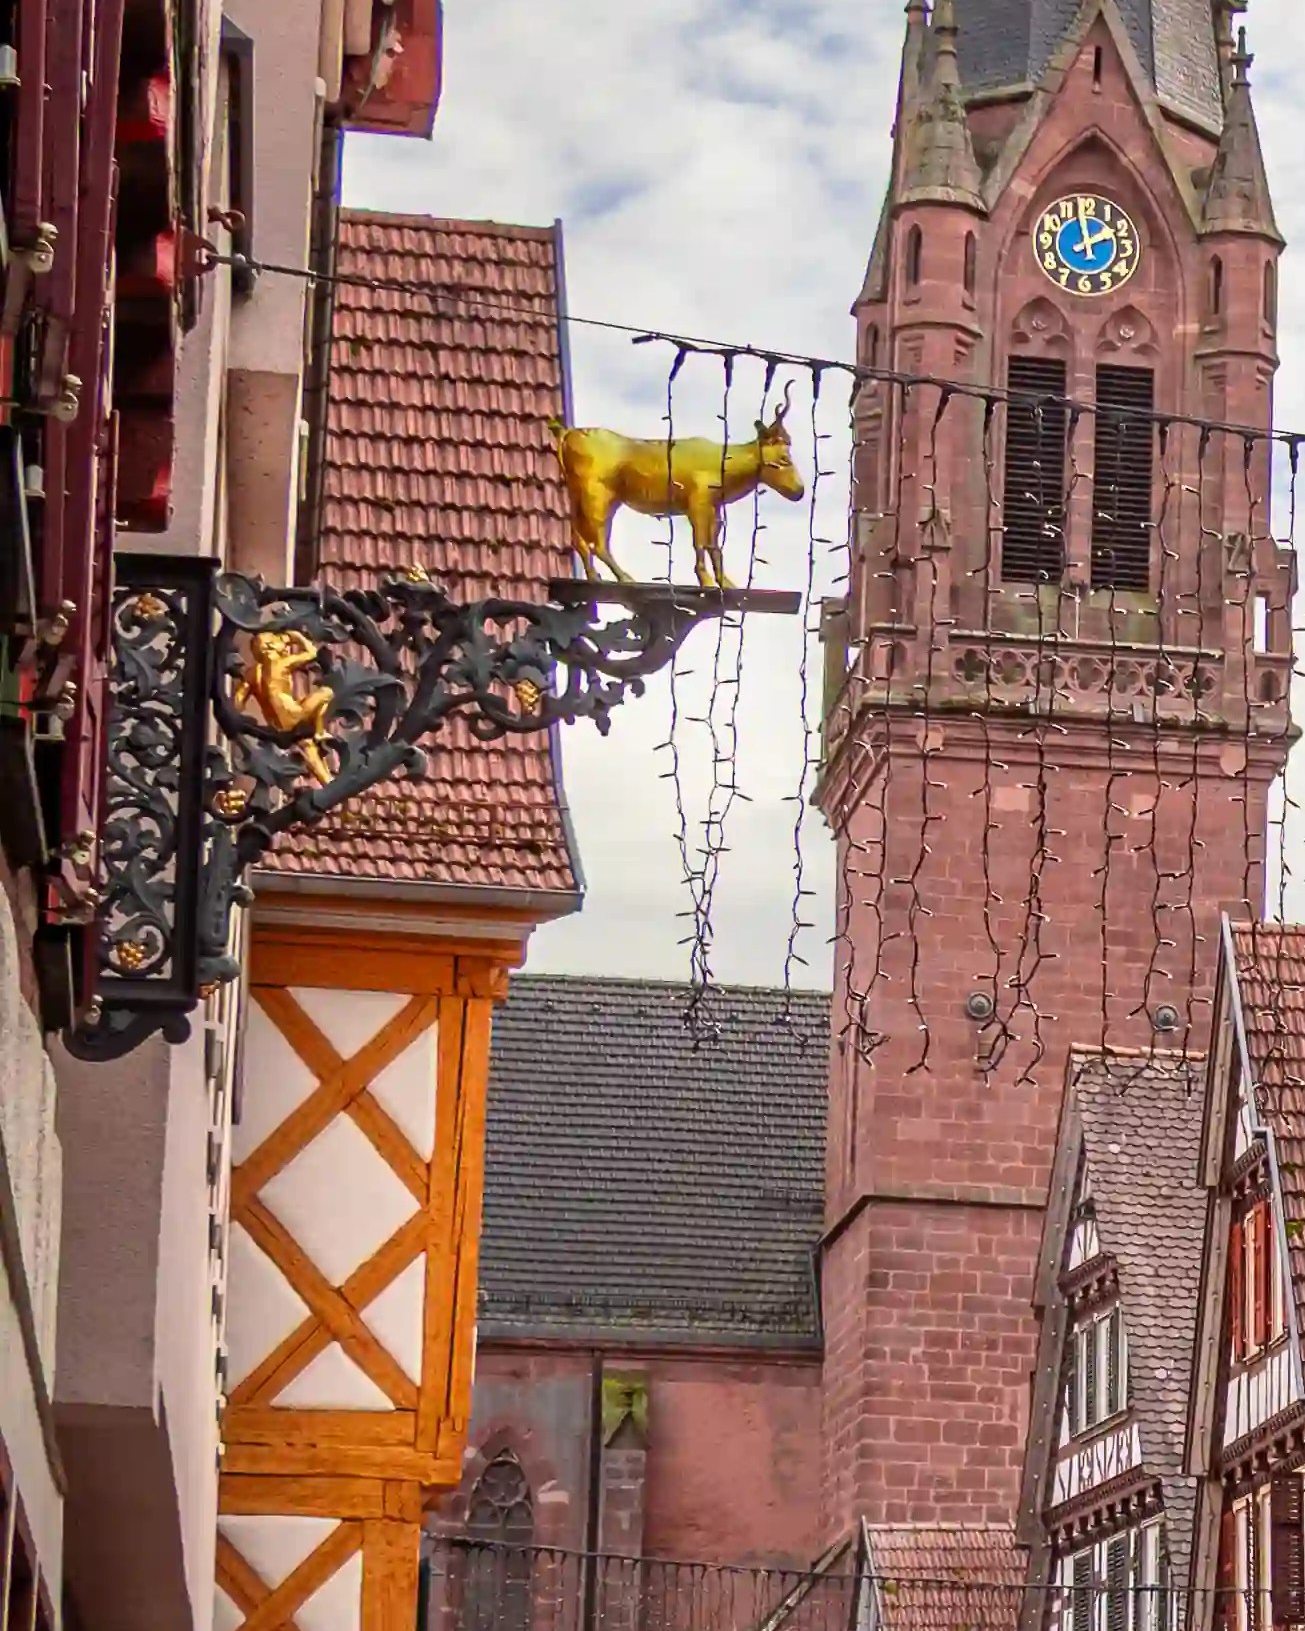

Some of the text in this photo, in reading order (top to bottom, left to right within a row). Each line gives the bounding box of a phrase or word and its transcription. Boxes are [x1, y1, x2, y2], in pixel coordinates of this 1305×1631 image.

[1060, 202, 1073, 218] 11
[1080, 197, 1096, 215] 12
[1104, 205, 1111, 221] 1
[1044, 214, 1060, 231] 10
[1117, 219, 1128, 236] 2
[1040, 232, 1052, 249] 9
[1120, 240, 1133, 257] 3
[1044, 252, 1056, 269] 8
[1112, 259, 1128, 276] 4
[1059, 268, 1070, 285] 7
[1078, 275, 1091, 291] 6
[1100, 272, 1112, 289] 5
